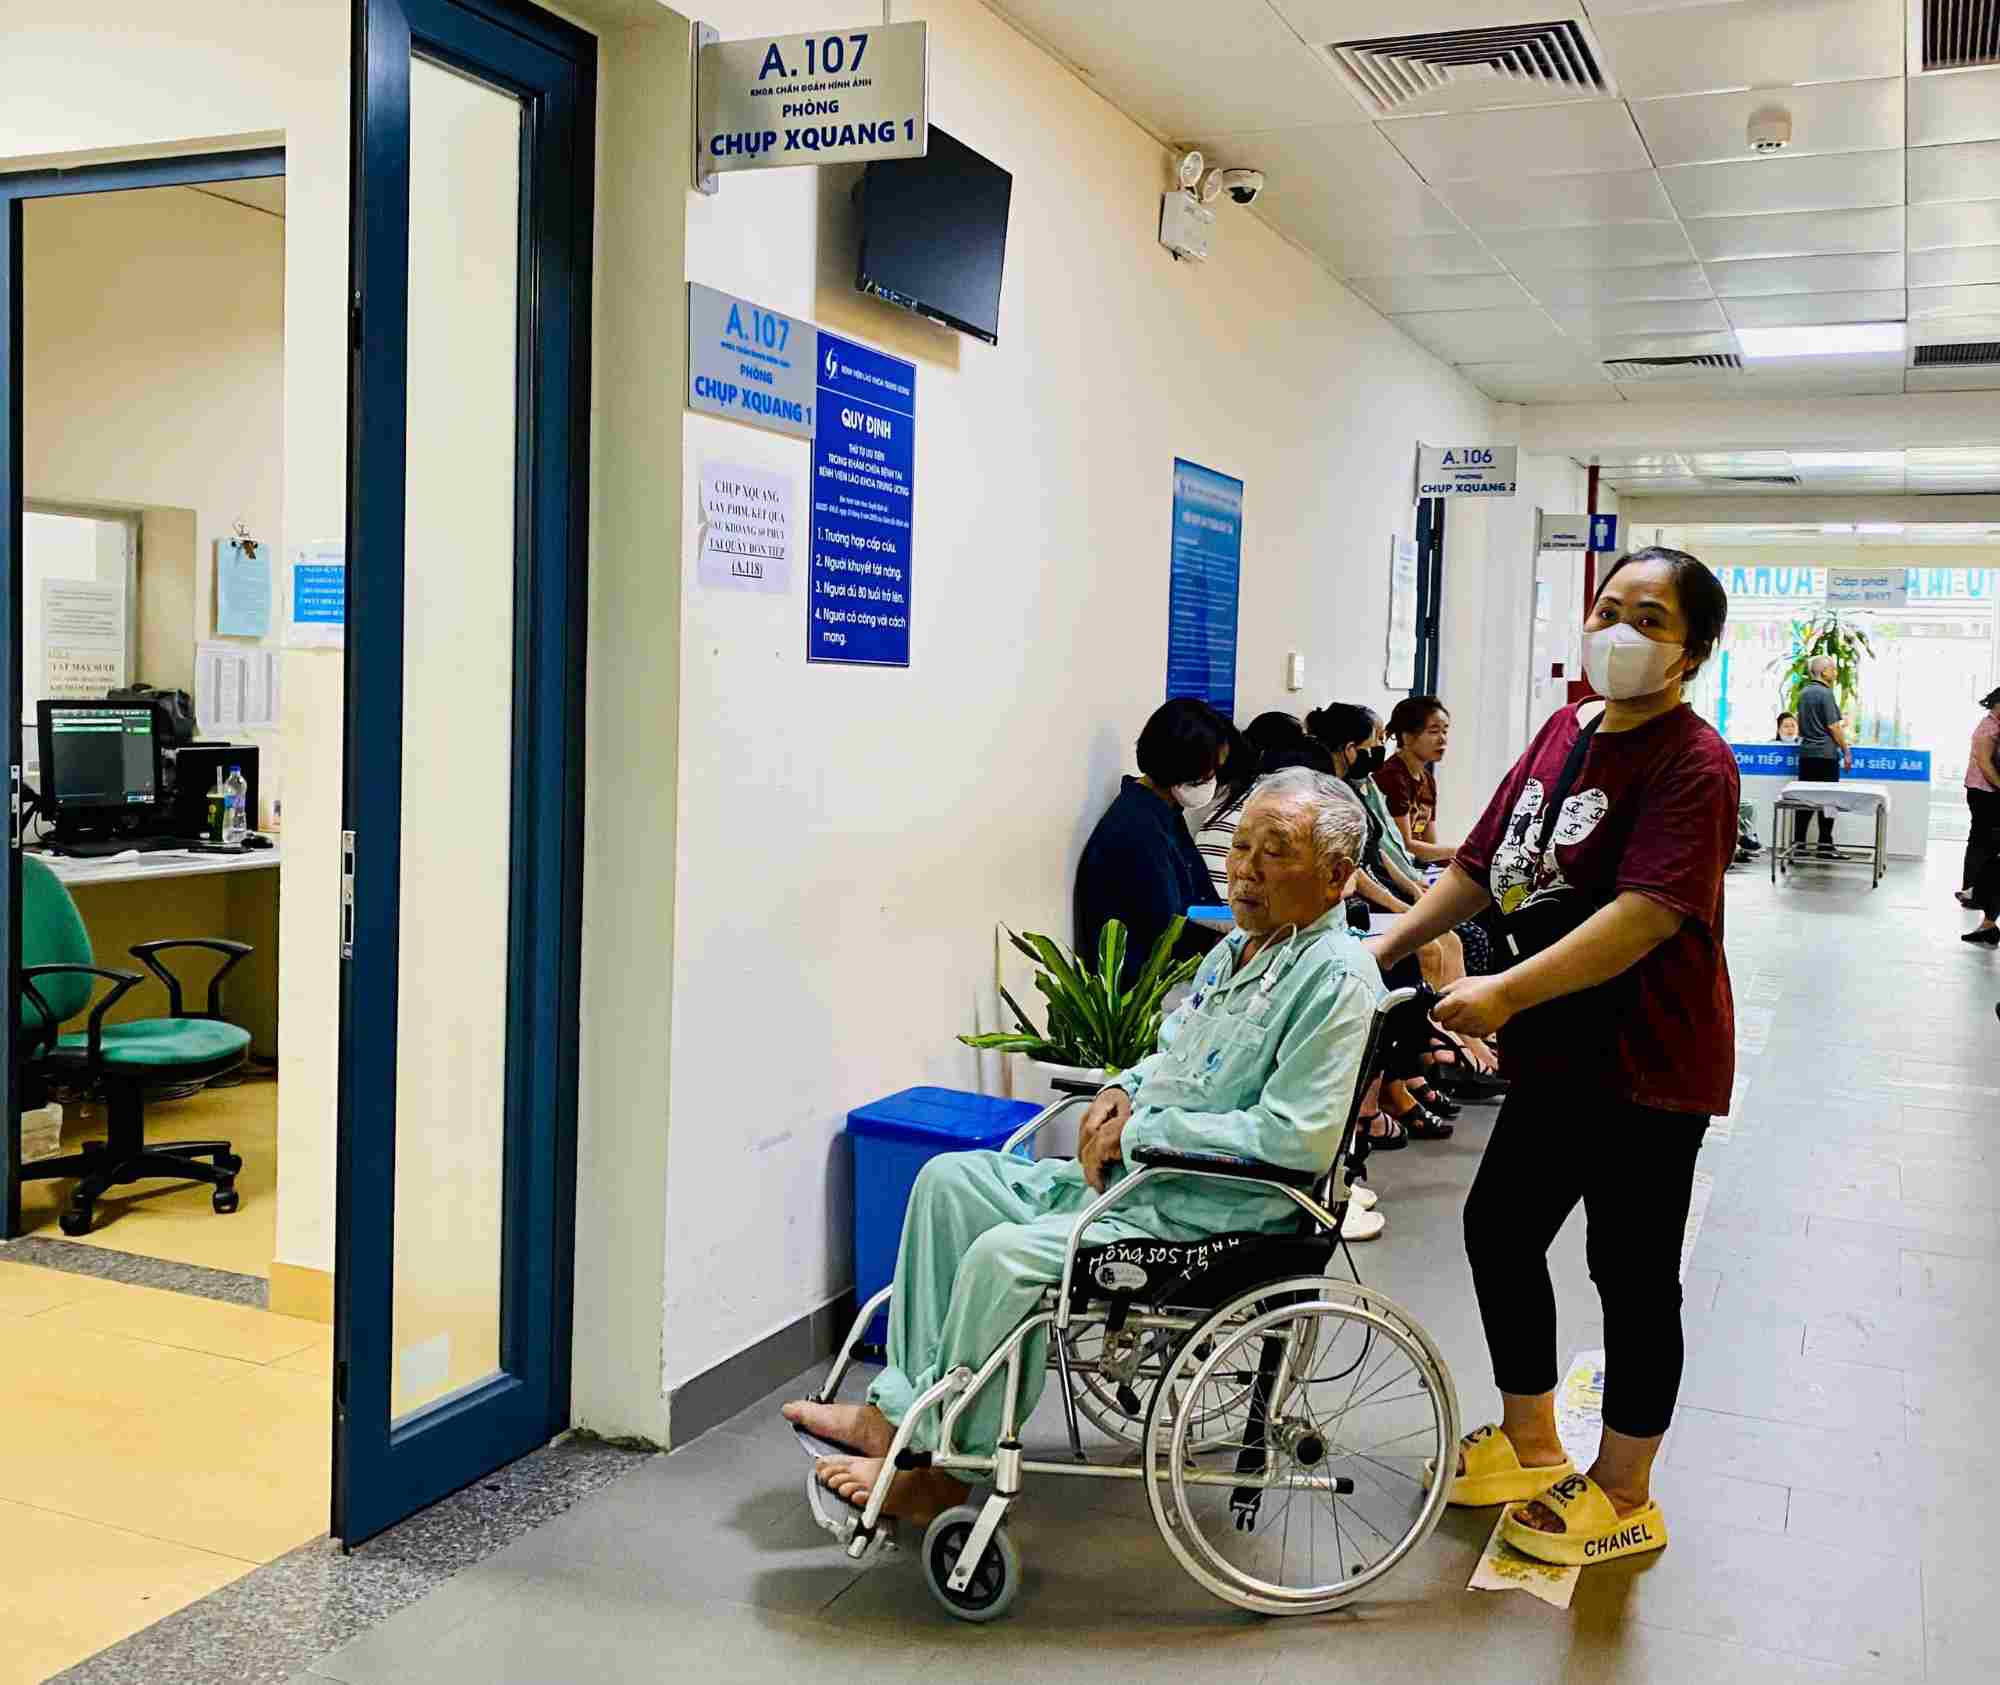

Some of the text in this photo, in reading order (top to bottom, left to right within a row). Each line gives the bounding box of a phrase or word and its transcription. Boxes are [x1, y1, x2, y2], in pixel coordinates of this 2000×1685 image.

[758, 33, 869, 81] A.107
[782, 98, 840, 118] PHÒNG
[709, 118, 914, 158] CHỤP XQUANG 1
[725, 303, 790, 353] A.107
[694, 375, 812, 425] CHỤP XQUANG 1
[841, 407, 892, 440] QUY ĐỊNH
[1442, 448, 1493, 465] A.106
[1455, 482, 1506, 493] XQUANG
[1509, 482, 1517, 492] 2
[1583, 1523, 1653, 1557] CHANEL
